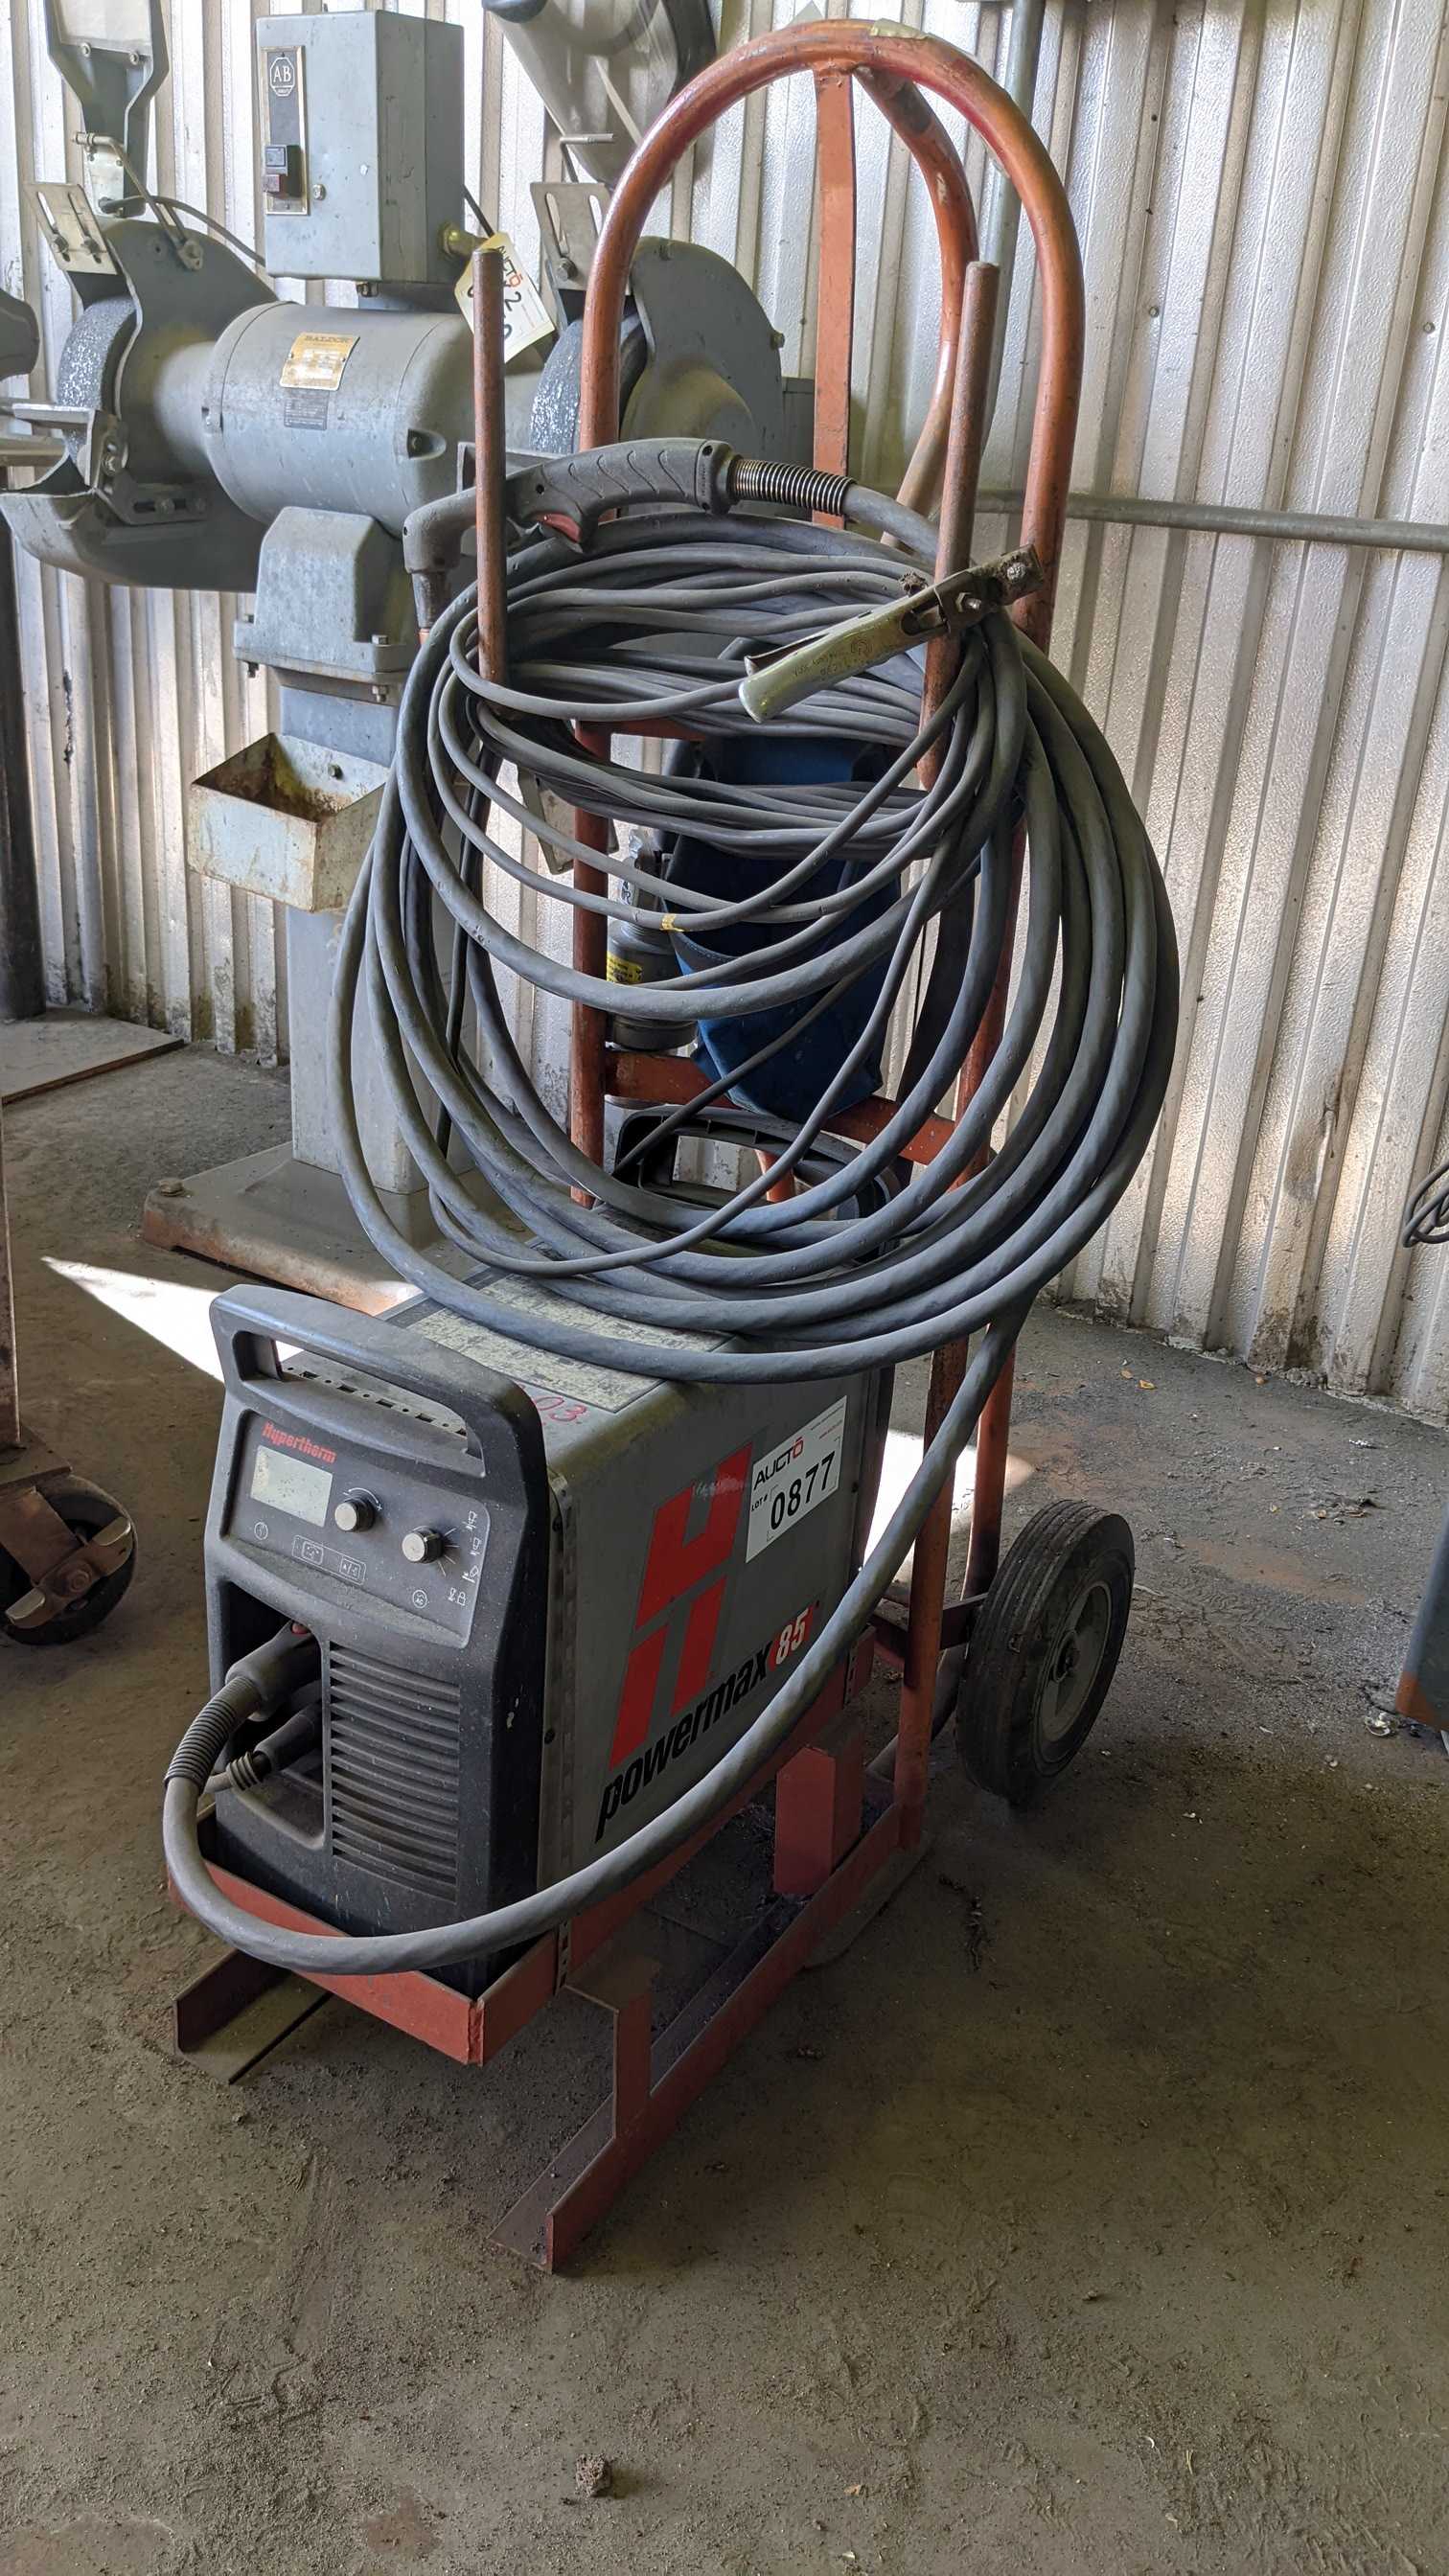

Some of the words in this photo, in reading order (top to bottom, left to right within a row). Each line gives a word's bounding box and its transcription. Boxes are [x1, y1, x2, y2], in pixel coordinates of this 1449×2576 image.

[272, 65, 292, 82] AB
[262, 1421, 336, 1464] Hypertherm
[750, 1497, 764, 1512] LOT
[770, 1450, 836, 1530] 0877
[595, 1640, 773, 1845] powermax
[775, 1608, 810, 1665] 85
